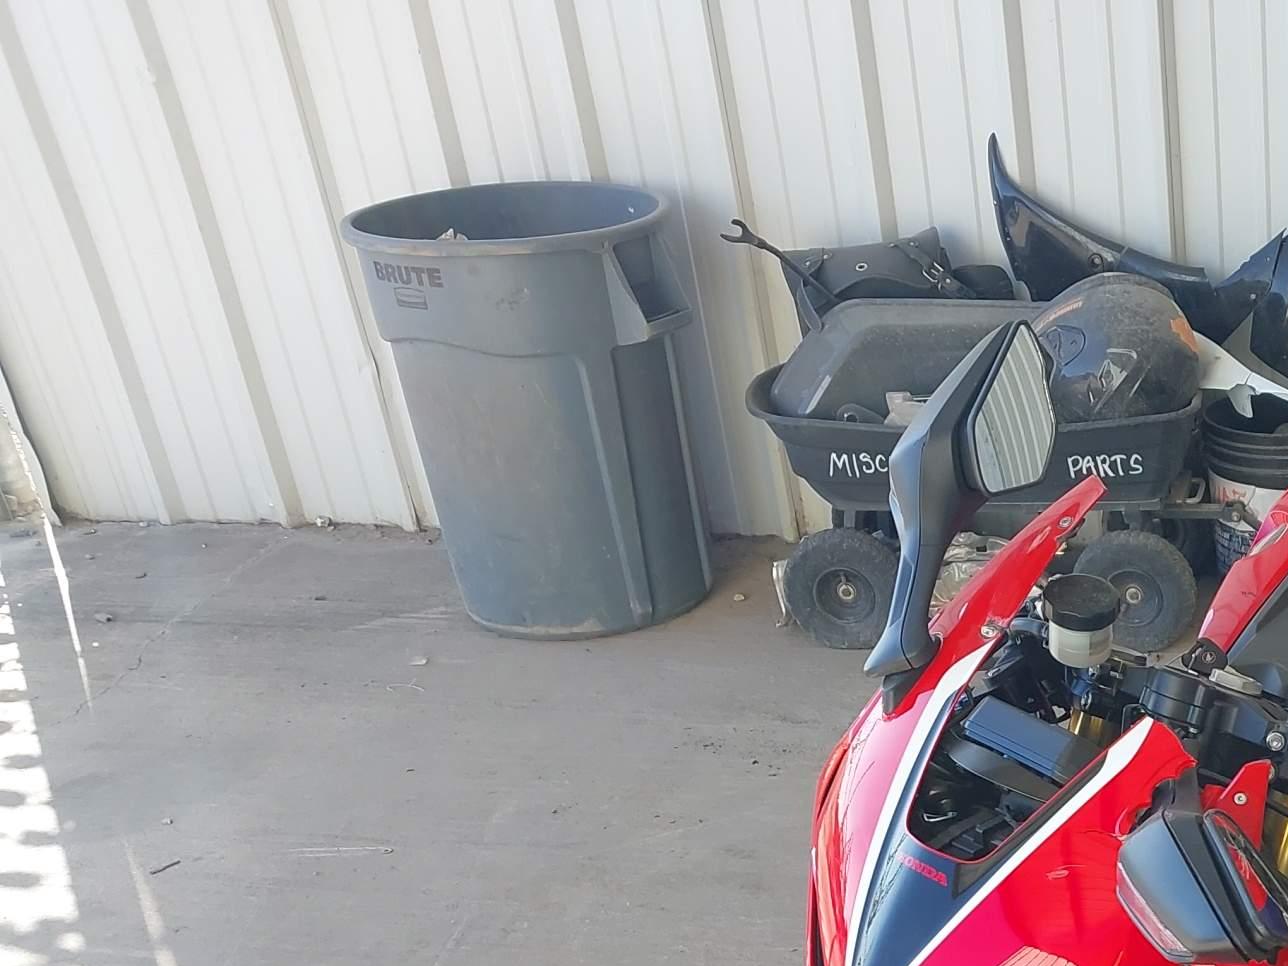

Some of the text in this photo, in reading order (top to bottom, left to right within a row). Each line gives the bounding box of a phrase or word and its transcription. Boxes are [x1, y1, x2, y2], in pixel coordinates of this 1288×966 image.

[373, 261, 444, 288] BRUTE
[829, 452, 1143, 479] MISC PARTS
